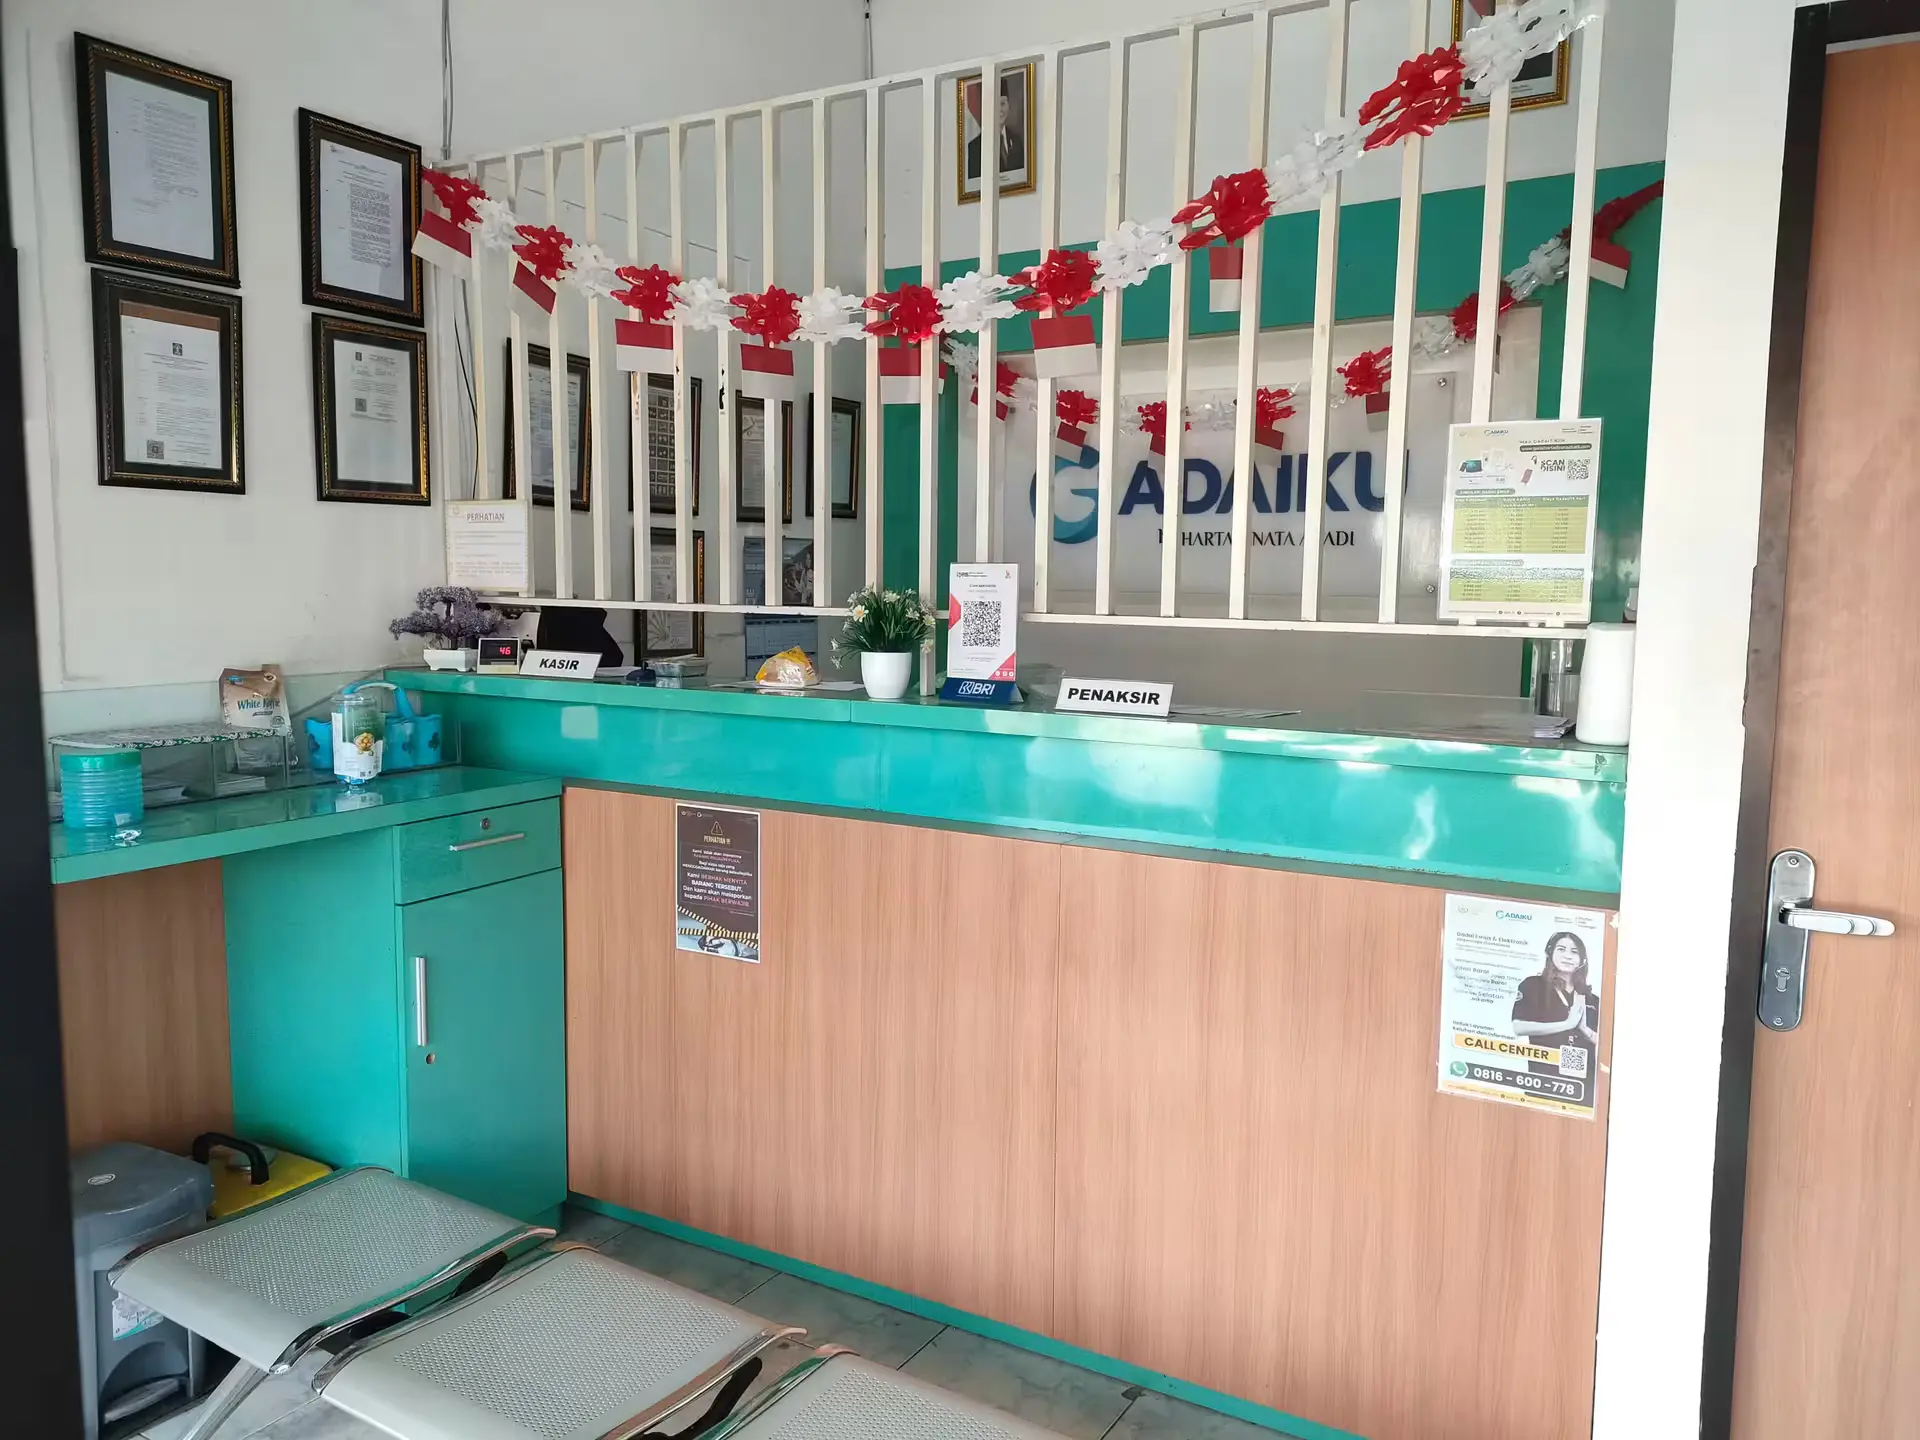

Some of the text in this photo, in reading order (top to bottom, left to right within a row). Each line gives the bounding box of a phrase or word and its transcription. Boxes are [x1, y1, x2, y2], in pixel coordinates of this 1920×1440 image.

[466, 512, 505, 521] PERHATIAN
[499, 646, 511, 655] 46
[539, 658, 580, 670] KASIR
[972, 682, 996, 695] BRI
[1067, 687, 1161, 706] PENAKSIR
[237, 698, 261, 710] White
[703, 835, 726, 844] PERHATIAN
[700, 873, 723, 881] BERHAK
[691, 879, 715, 888] BARANG
[684, 892, 703, 900] kepada
[703, 895, 720, 904] PIHAK
[693, 886, 707, 894] kami
[707, 888, 720, 896] akan
[720, 891, 753, 900] melaporkan
[1498, 937, 1529, 945] Elektronik
[1464, 1037, 1550, 1060] CALL CENTER
[1473, 1067, 1503, 1082] 0816
[1516, 1075, 1542, 1088] 600
